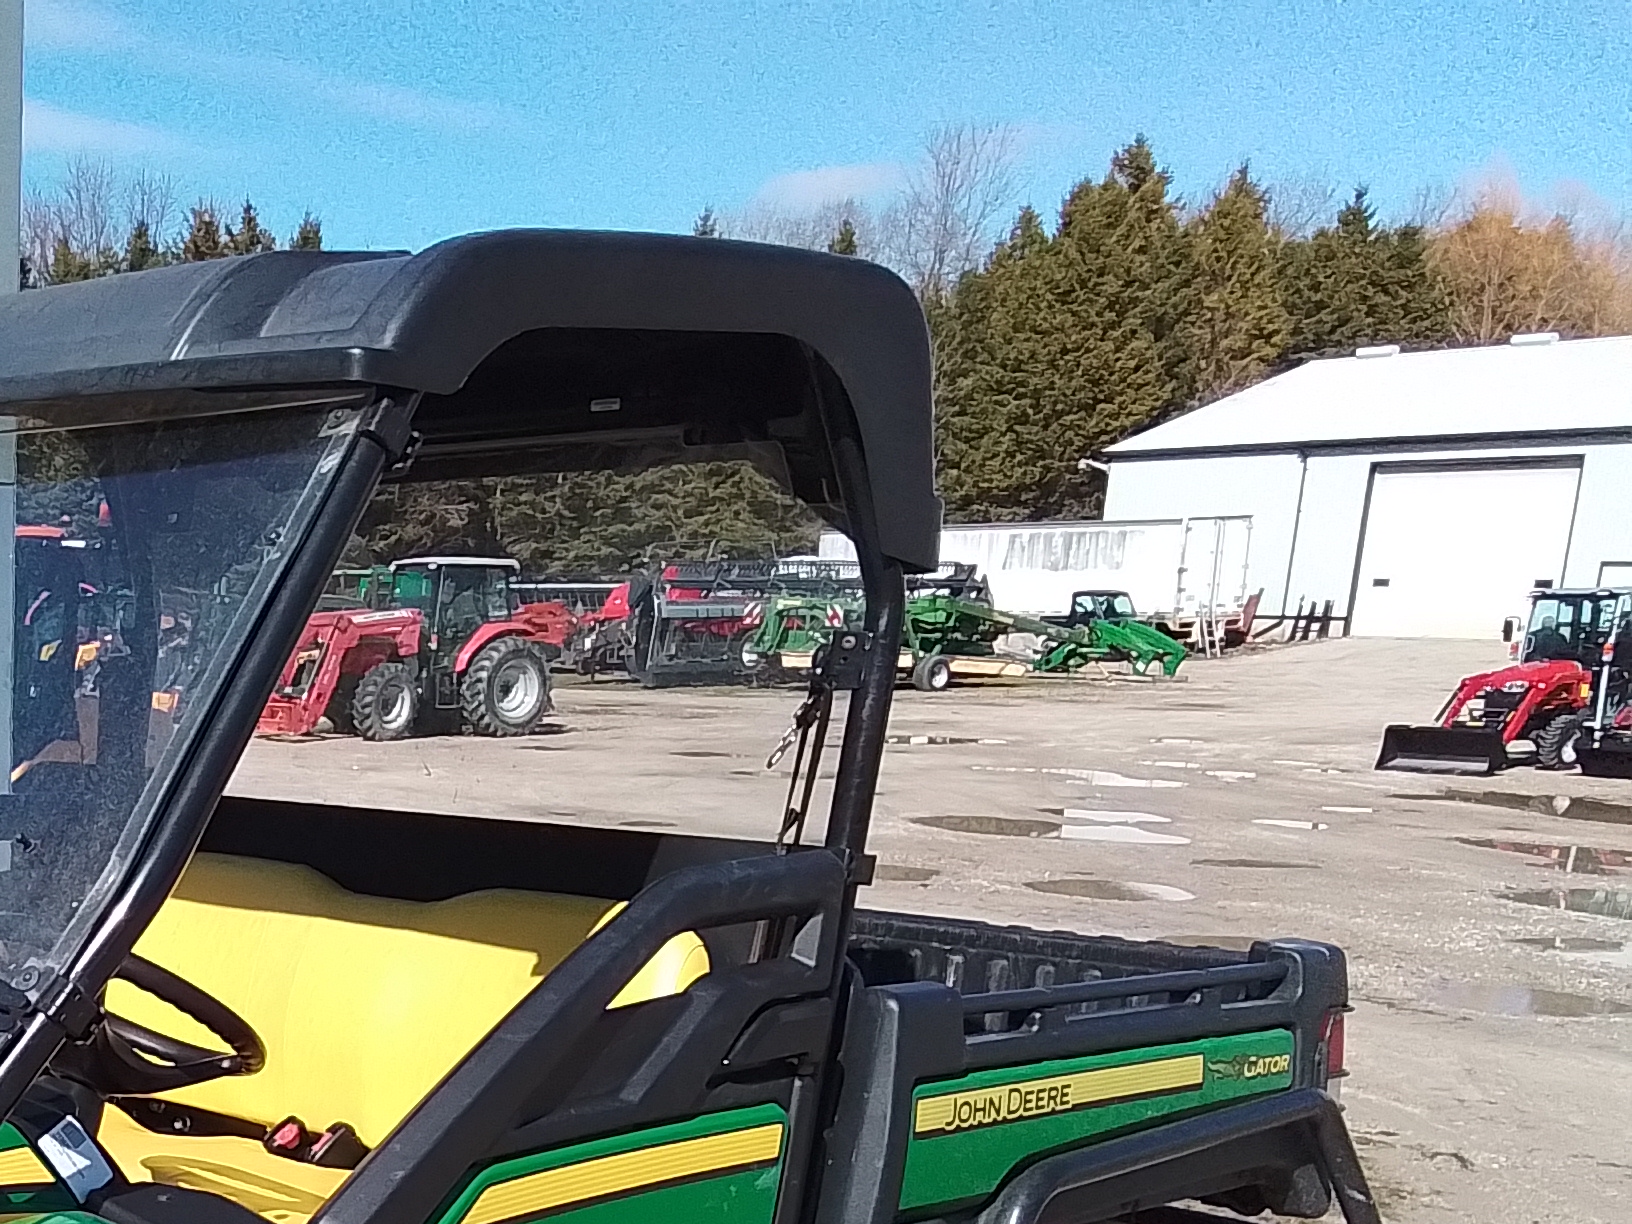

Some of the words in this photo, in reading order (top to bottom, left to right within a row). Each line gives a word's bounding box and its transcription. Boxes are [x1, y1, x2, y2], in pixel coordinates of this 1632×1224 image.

[1243, 1054, 1291, 1077] GATOR
[945, 1091, 1001, 1126] JOHN
[1007, 1084, 1072, 1116] DEERE
